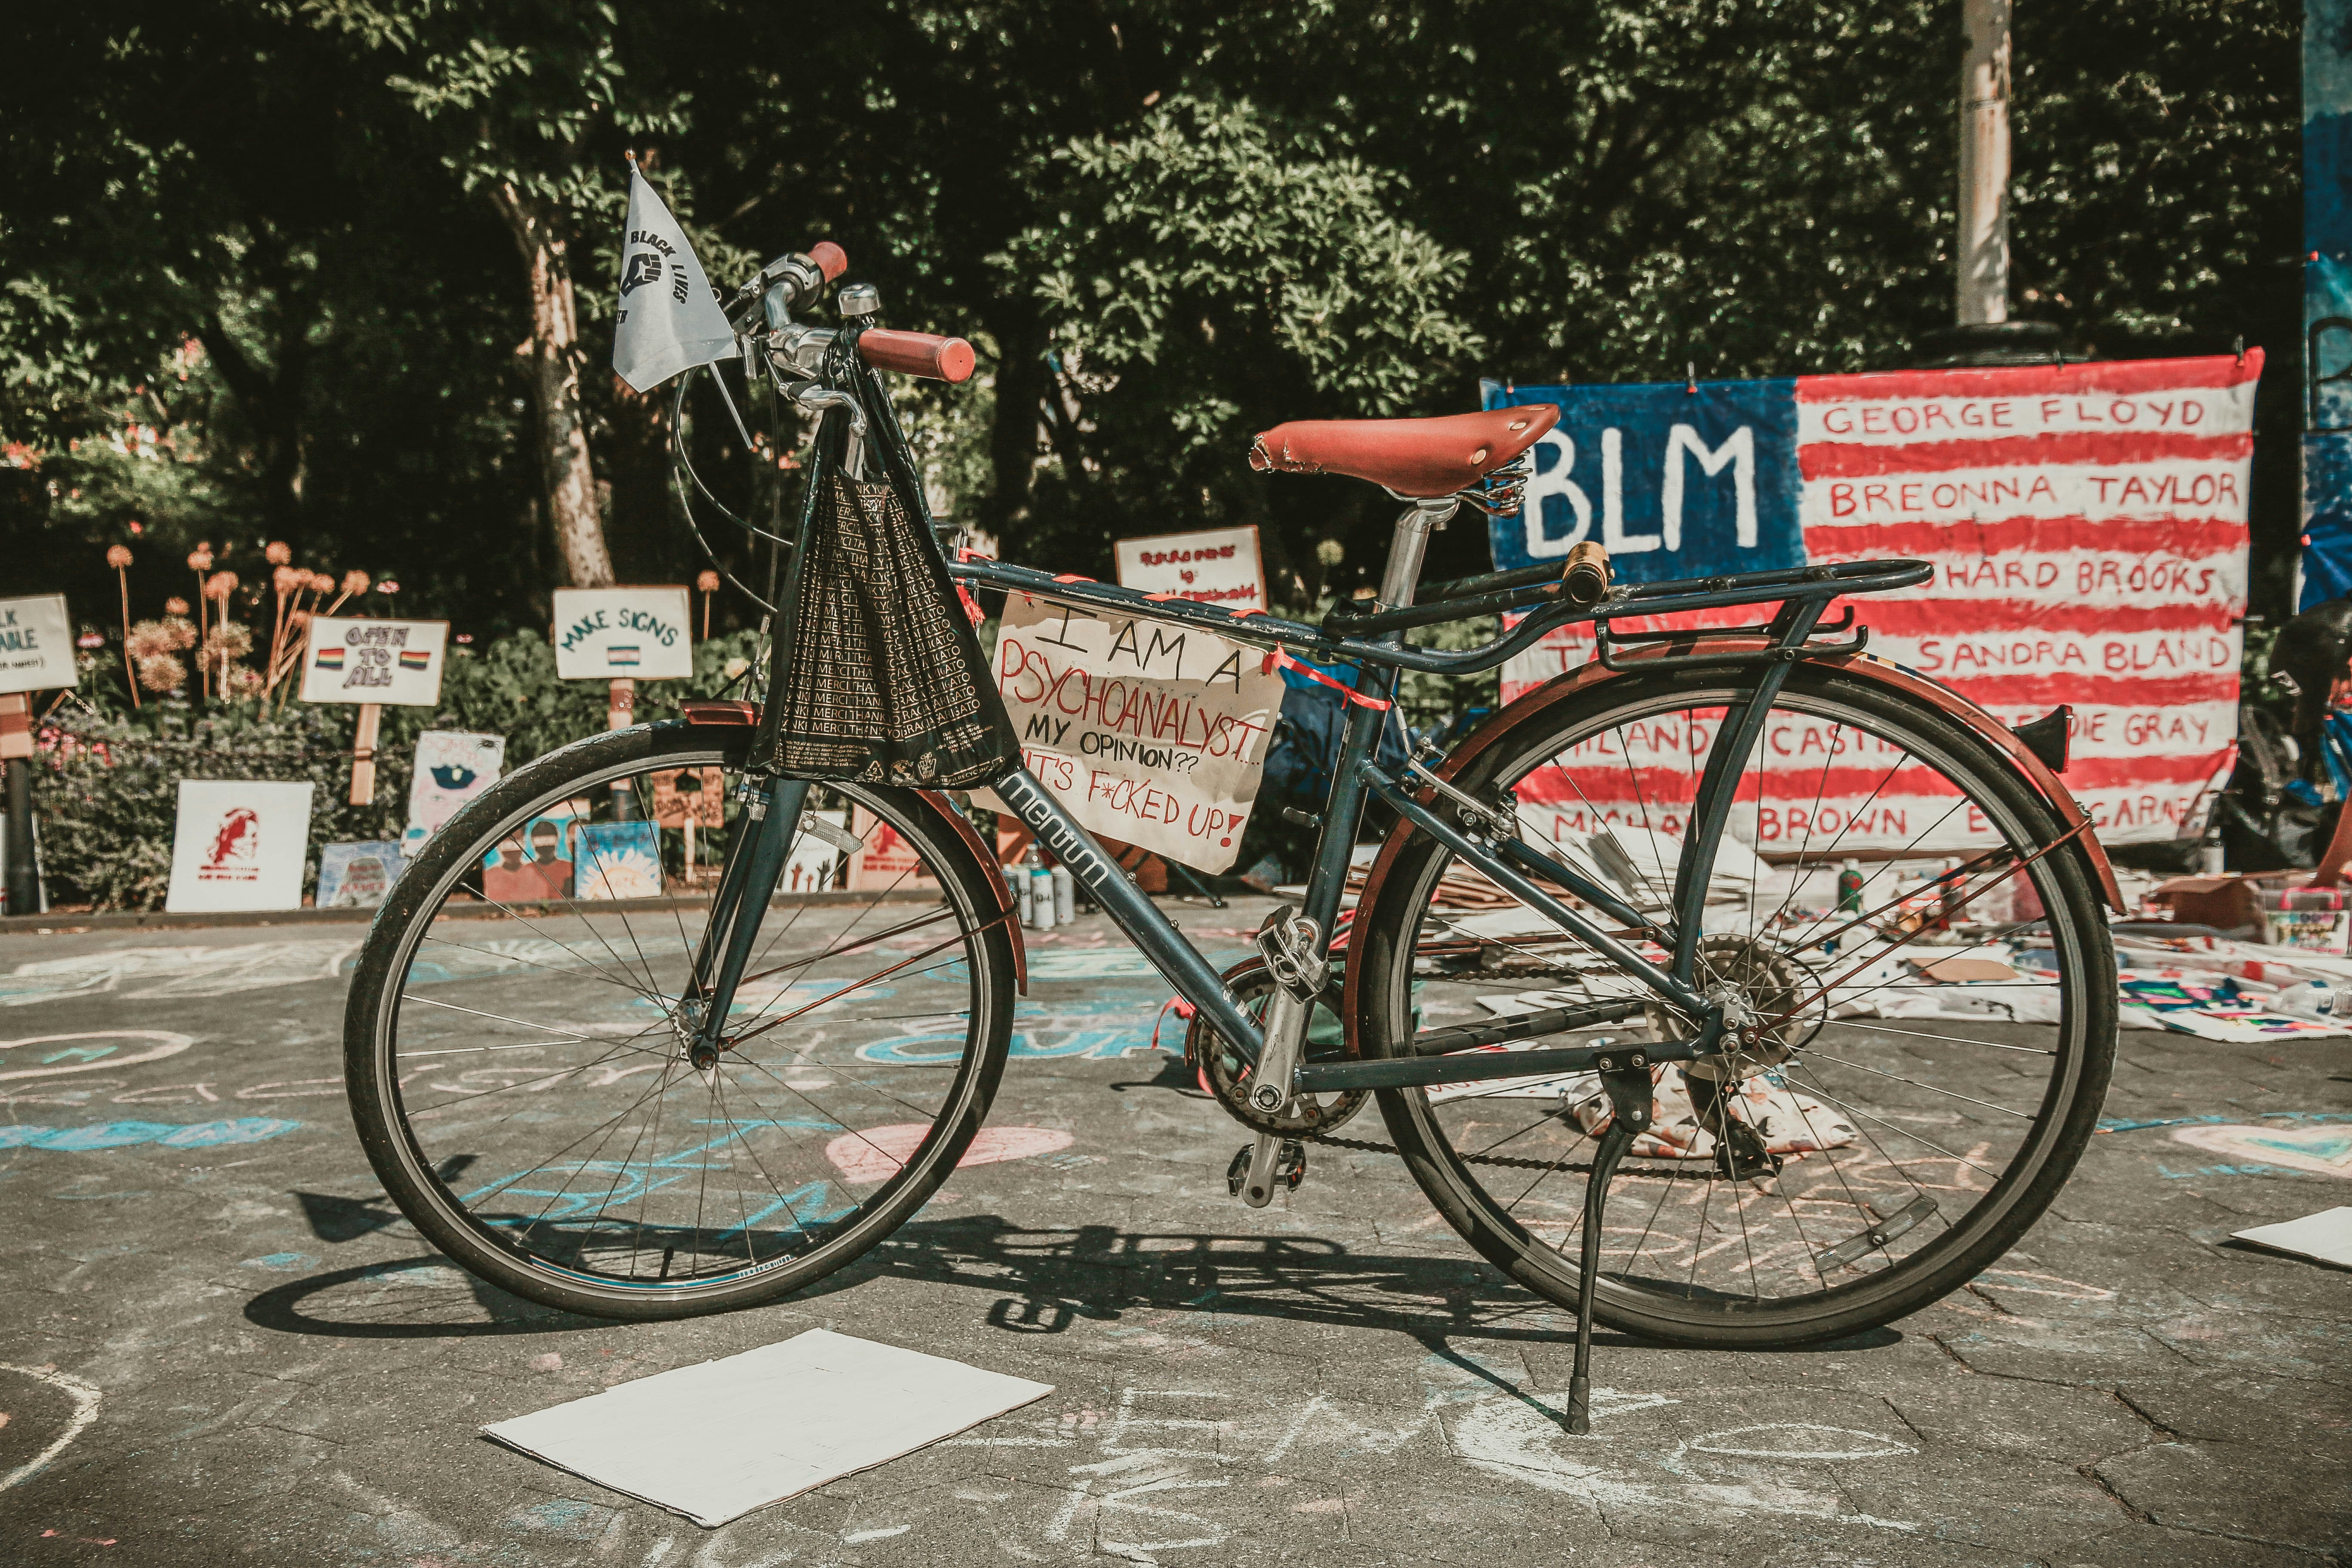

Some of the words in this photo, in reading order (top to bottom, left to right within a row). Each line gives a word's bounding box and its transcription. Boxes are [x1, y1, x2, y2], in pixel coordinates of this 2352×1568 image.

[631, 230, 677, 258] BLACK
[671, 264, 689, 304] LIVES
[1823, 401, 2014, 434] GEORGE
[2040, 400, 2203, 426] FLOYD
[1524, 423, 1757, 559] BLM
[1830, 475, 2058, 517] BREONNA
[2088, 472, 2239, 507] TAYLOR
[2076, 560, 2215, 596] BROOKS
[346, 627, 410, 646] OPEN
[560, 610, 609, 653] MAKE
[618, 607, 678, 646] SIGNS
[359, 648, 391, 666] TO
[852, 652, 872, 663] THA
[1035, 600, 1098, 653] I
[1107, 620, 1186, 681] AM
[1205, 649, 1242, 694] A
[1915, 640, 2086, 672] SANDRA
[2103, 638, 2231, 672] BLAND
[343, 666, 392, 689] ALL
[817, 678, 848, 691] MERCI
[852, 667, 873, 677] THA
[814, 707, 847, 720] MERCI
[815, 692, 848, 705] MERCI
[851, 695, 883, 707] THAN
[812, 722, 846, 734] MERCI
[1025, 713, 1071, 746] MY
[1079, 731, 1199, 775] OPINION??
[2125, 714, 2210, 745] GRAY
[998, 774, 1109, 890] mentum
[1187, 803, 1245, 847] UP!
[1758, 808, 1906, 840] BROWN
